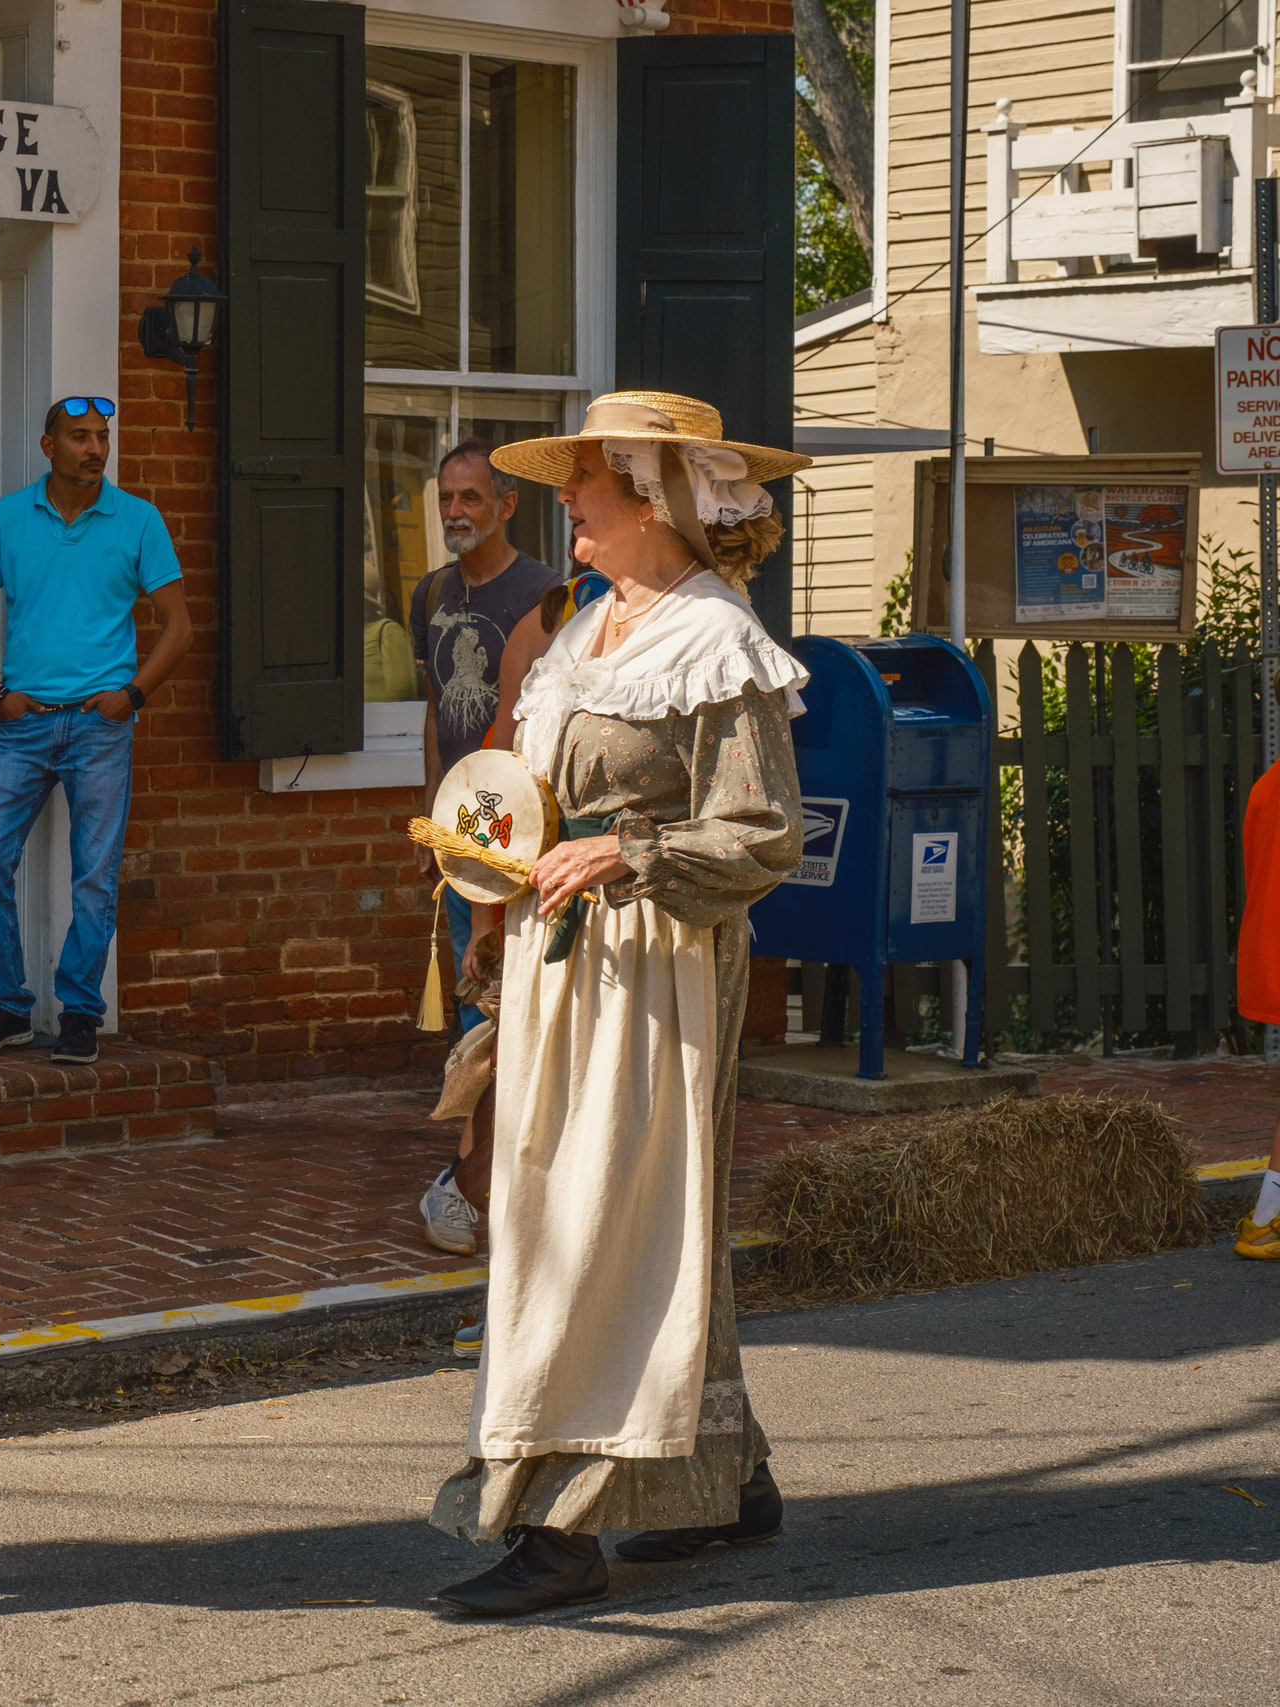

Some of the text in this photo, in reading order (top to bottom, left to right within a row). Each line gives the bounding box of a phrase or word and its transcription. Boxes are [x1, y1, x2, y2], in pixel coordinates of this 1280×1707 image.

[15, 167, 70, 215] VA
[1237, 400, 1280, 413] SERVI
[1106, 487, 1184, 495] WATERFORD
[1033, 525, 1062, 533] AUTUMN
[1022, 532, 1069, 540] CELEBRATION
[802, 861, 828, 870] STATES
[800, 870, 830, 881] SERVICE
